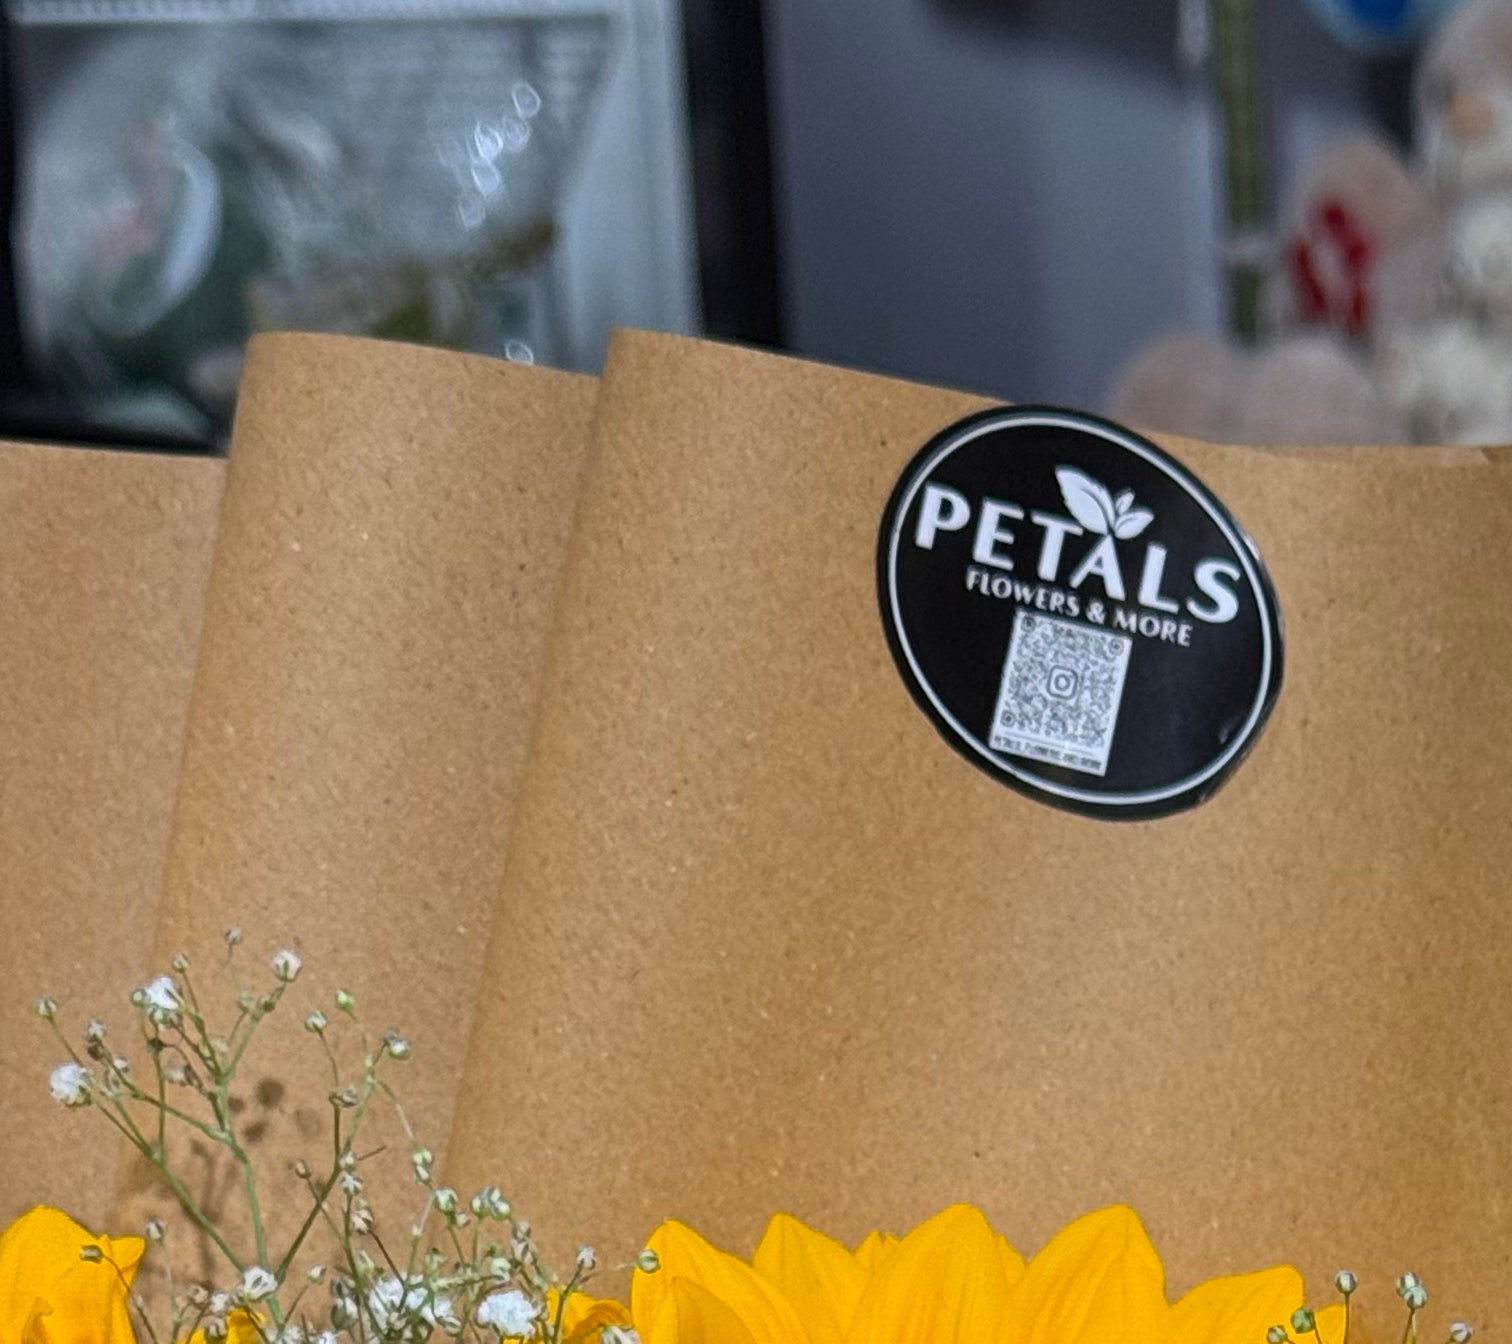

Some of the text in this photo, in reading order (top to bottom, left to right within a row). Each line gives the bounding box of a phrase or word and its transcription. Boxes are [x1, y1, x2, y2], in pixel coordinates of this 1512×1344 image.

[915, 481, 1241, 624] PETALS
[965, 566, 1193, 648] FLOWERS & MORE
